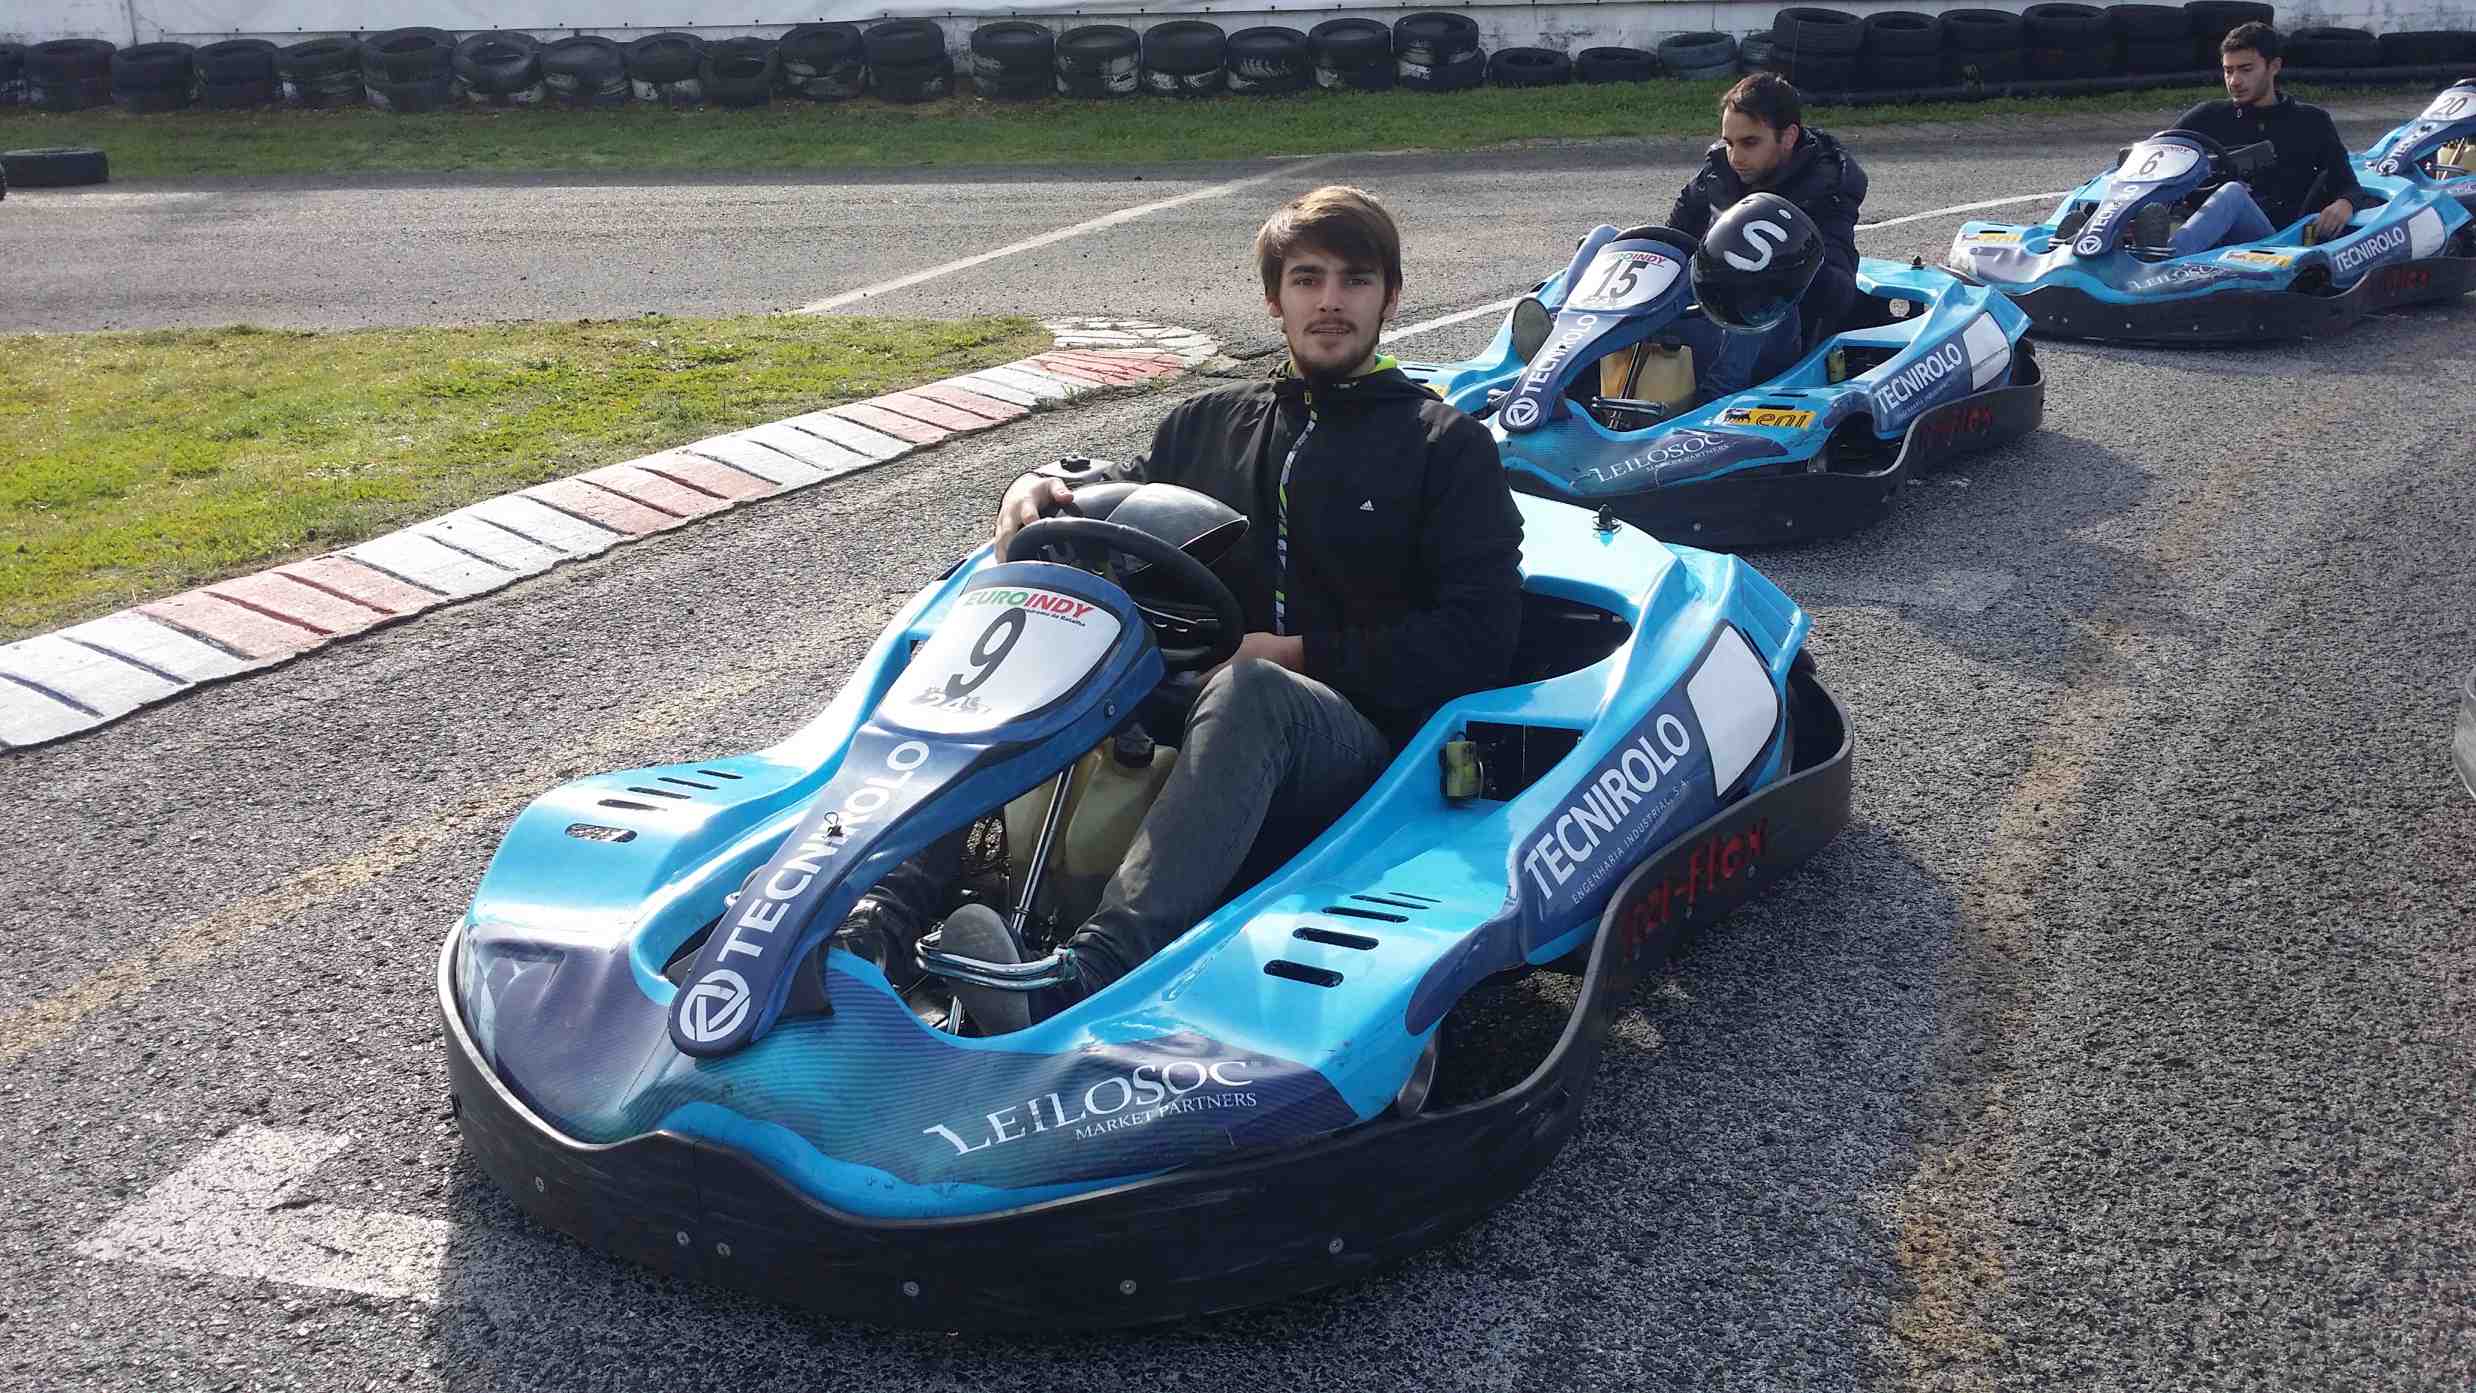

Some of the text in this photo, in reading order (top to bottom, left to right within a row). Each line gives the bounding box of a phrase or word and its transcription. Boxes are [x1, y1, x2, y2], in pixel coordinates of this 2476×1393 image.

[2432, 97, 2468, 116] 20
[2139, 150, 2164, 176] 6
[2335, 226, 2406, 272] TECNIROLO
[1592, 259, 1649, 298] 15
[1873, 343, 1961, 414] TECNIROLO
[1756, 413, 1808, 429] eni
[1589, 431, 1725, 482] LEILOSOC
[963, 590, 1095, 618] EUROINDY
[944, 607, 1026, 699] 9
[1524, 713, 1690, 900] TECNIROLO
[1571, 847, 1625, 905] ENGENHARIA
[923, 1061, 1253, 1156] LEILOSOC
[1074, 1092, 1257, 1141] MARKET PARTNERS
